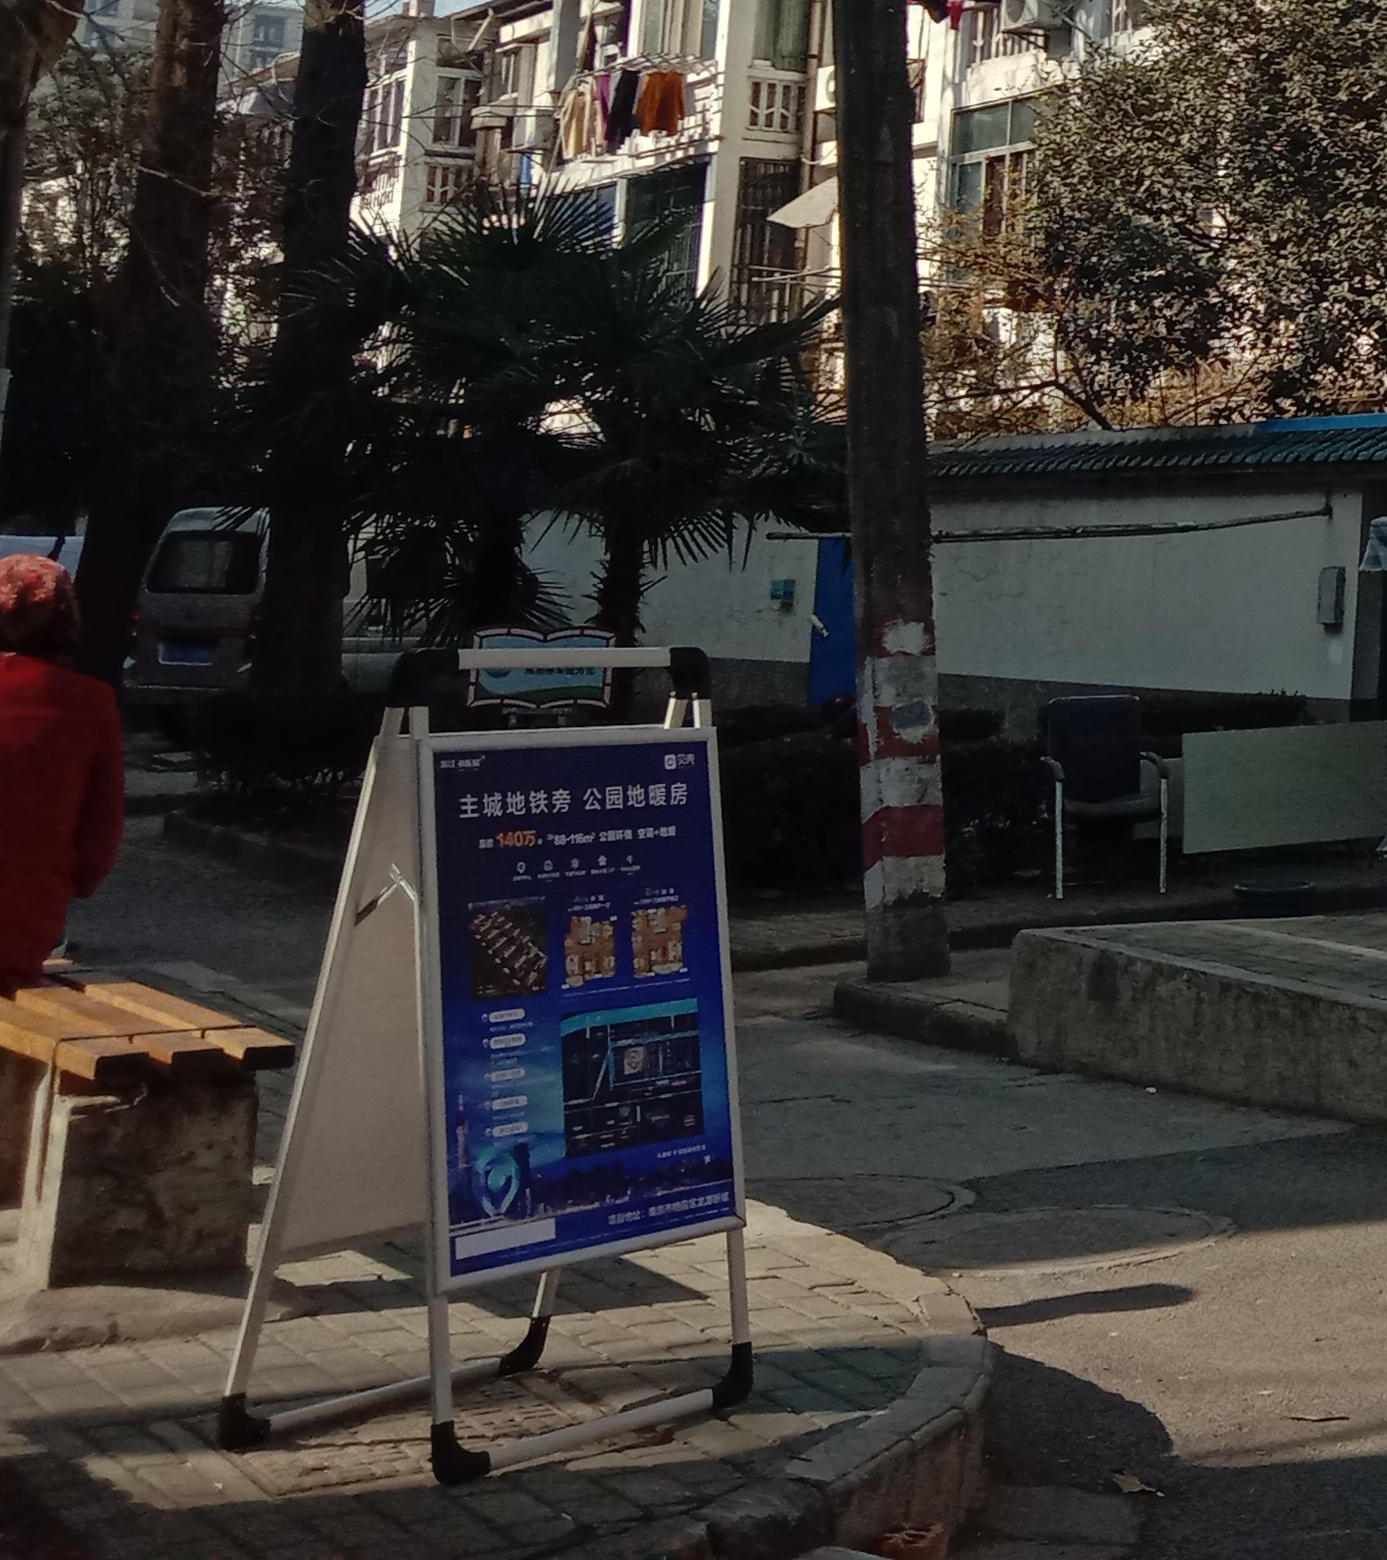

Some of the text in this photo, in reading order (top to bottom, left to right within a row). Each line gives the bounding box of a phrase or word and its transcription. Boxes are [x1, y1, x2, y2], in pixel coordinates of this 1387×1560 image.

[459, 782, 689, 820] 主城地铁旁 公园地暖房
